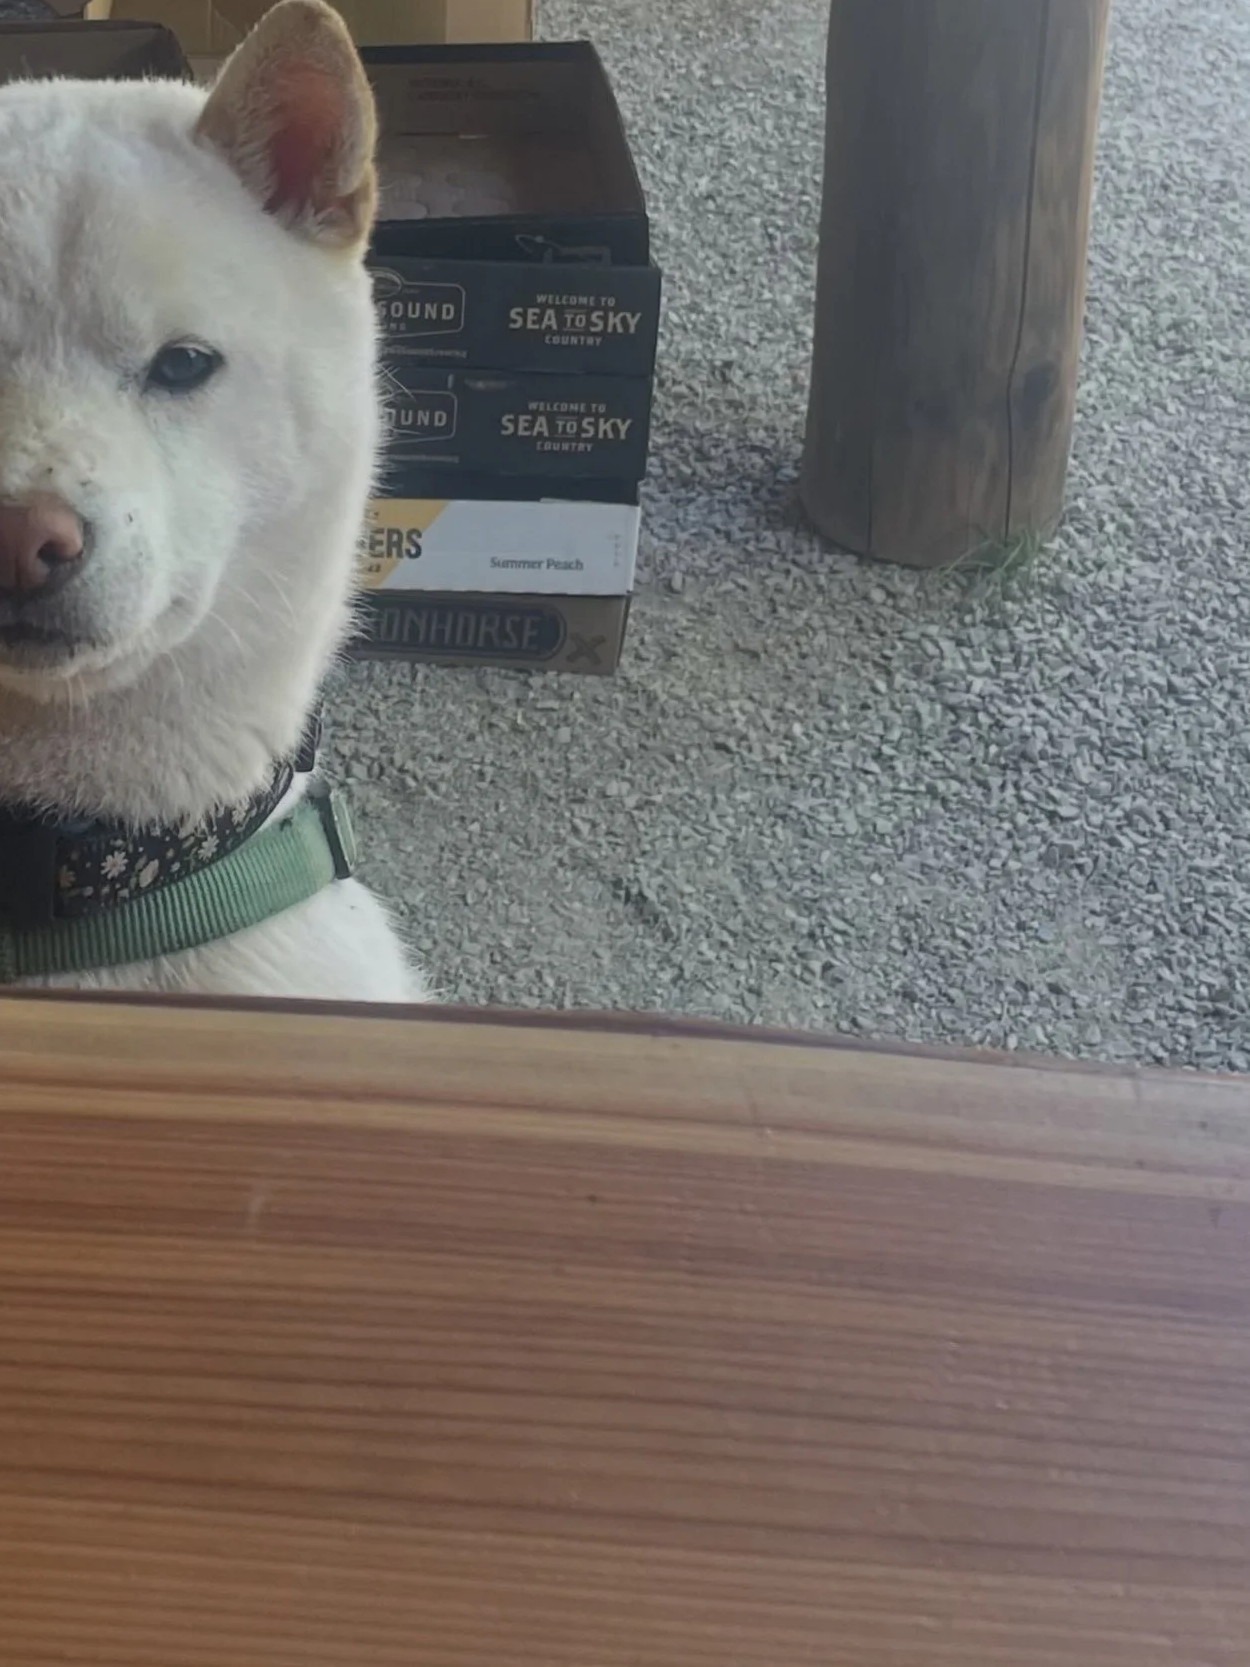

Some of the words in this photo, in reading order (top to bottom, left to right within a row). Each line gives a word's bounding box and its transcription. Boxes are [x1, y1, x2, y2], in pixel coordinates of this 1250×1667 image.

[535, 293, 596, 307] WELCOME
[599, 296, 617, 307] TO
[508, 307, 558, 331] SEA
[564, 313, 586, 328] TO
[589, 310, 642, 334] SKY
[544, 334, 603, 347] COUNTRY
[527, 400, 587, 414] WELCOME
[590, 402, 607, 414] TO
[383, 407, 448, 427] OUND
[500, 414, 549, 437] SEA
[555, 420, 578, 435] TO
[580, 417, 633, 440] SKY
[536, 441, 594, 453] COUNTRY
[367, 527, 423, 560] ERS
[489, 556, 543, 571] Summer
[546, 557, 584, 572] Peach
